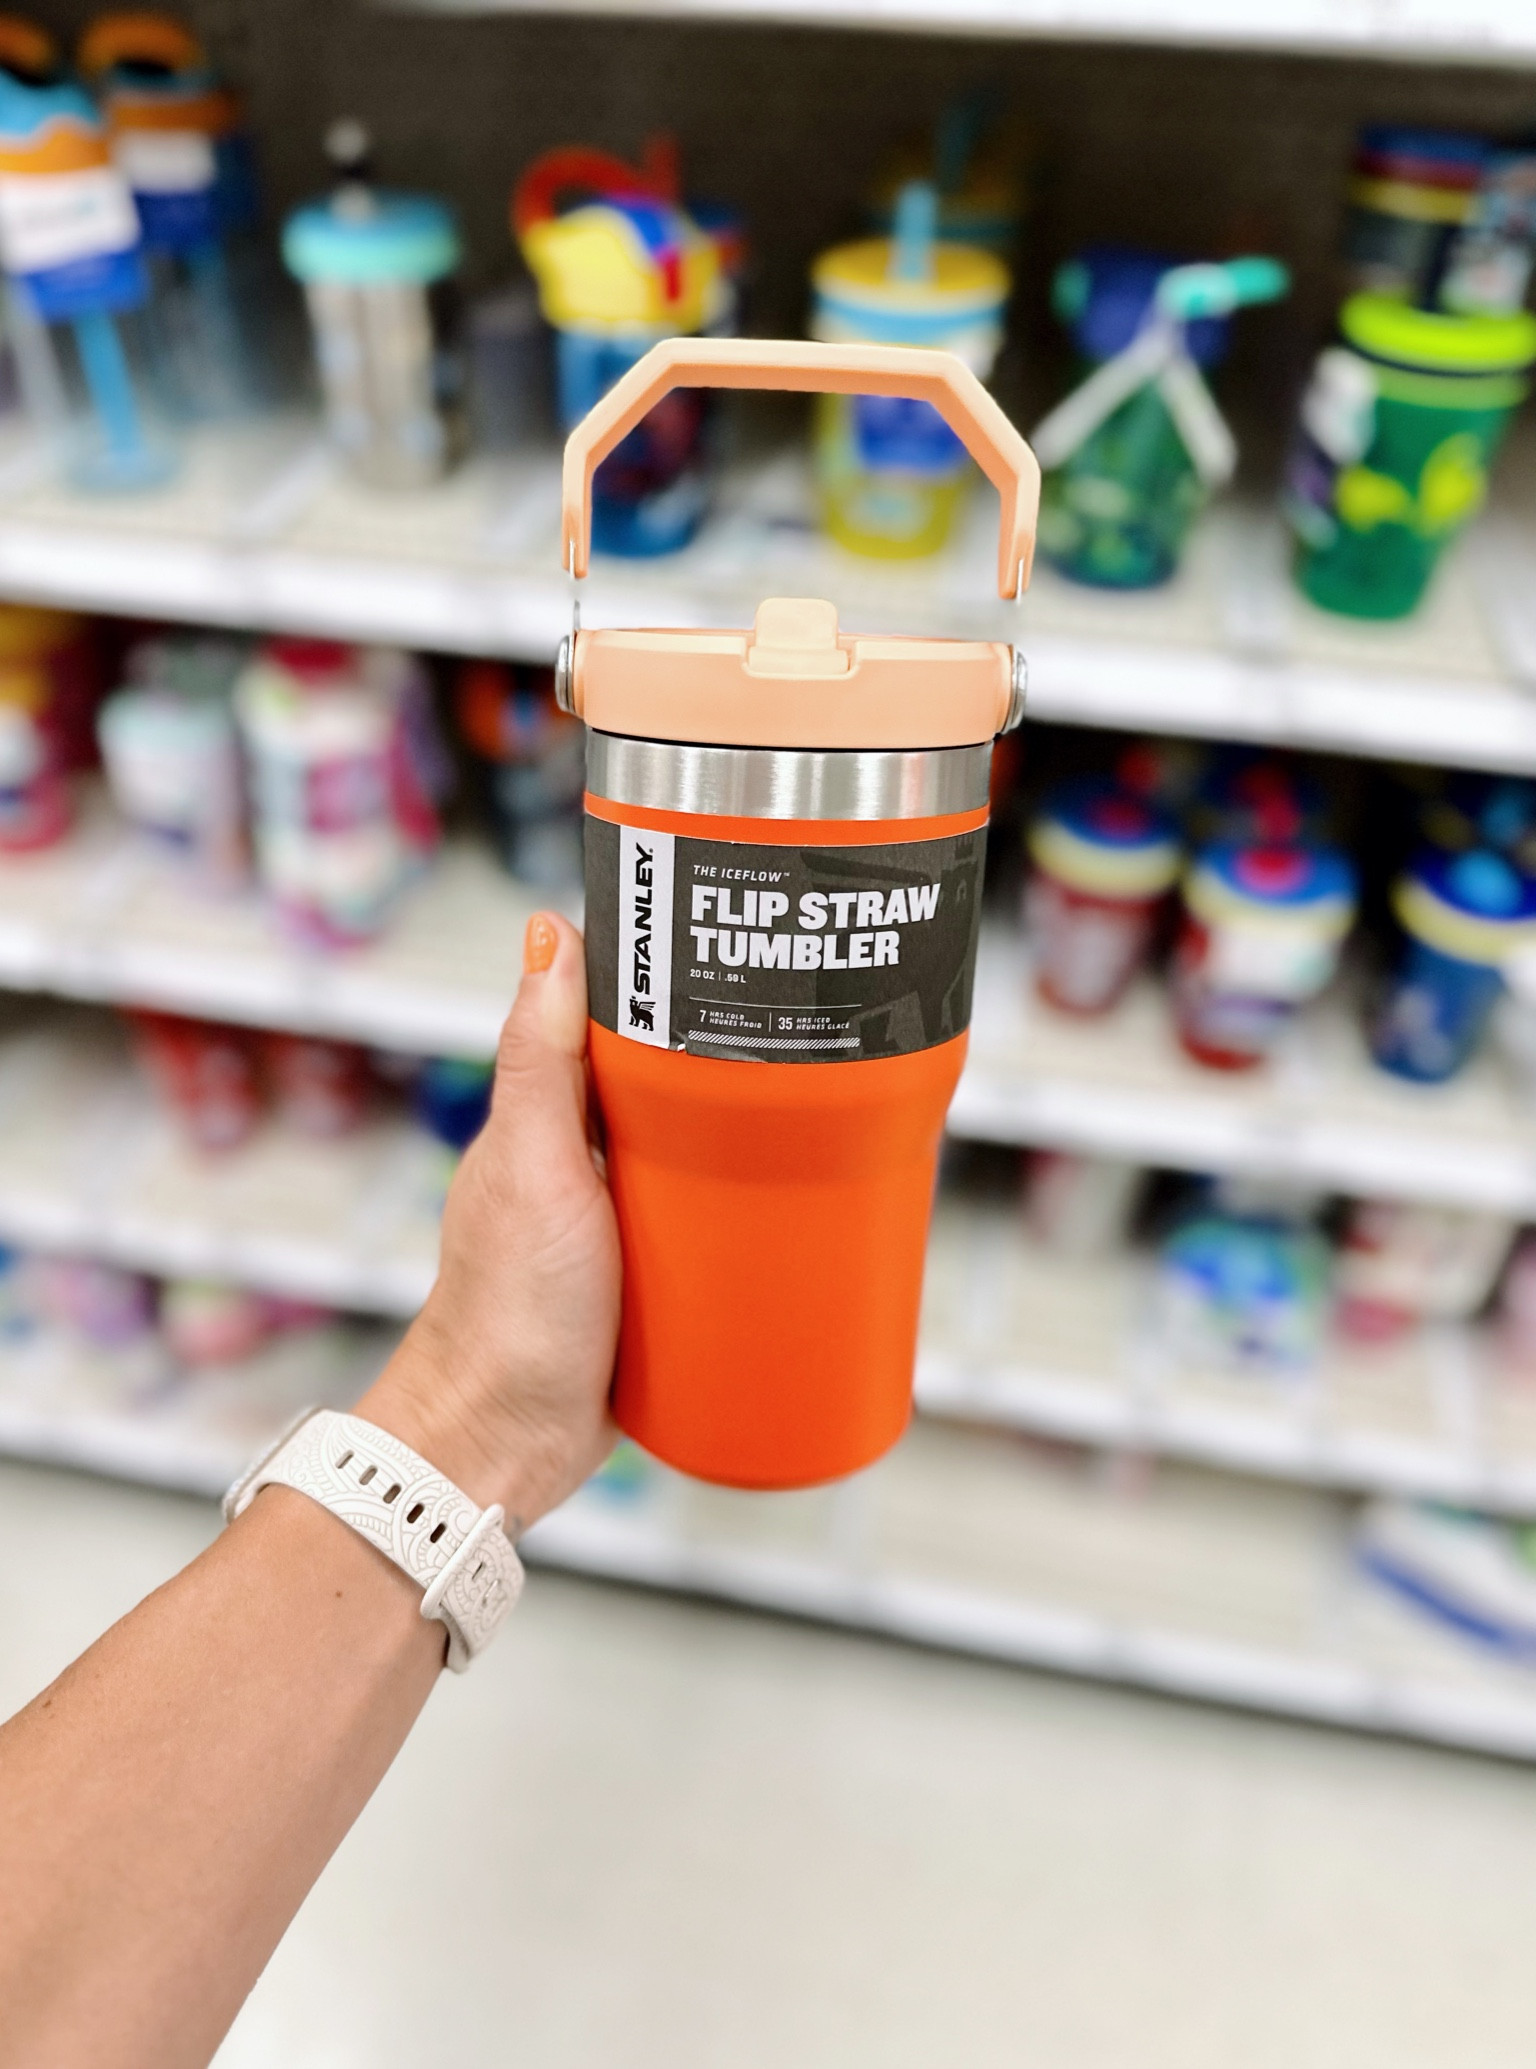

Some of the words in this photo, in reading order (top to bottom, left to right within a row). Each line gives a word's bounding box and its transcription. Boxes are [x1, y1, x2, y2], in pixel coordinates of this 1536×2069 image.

[693, 864, 717, 877] THE
[691, 884, 789, 927] FLIP
[798, 883, 941, 930] STRAW
[690, 925, 900, 971] TUMBLER
[689, 968, 701, 978] 20
[703, 970, 715, 980] OZ
[740, 975, 747, 984] L
[699, 1010, 707, 1022] 7
[710, 1011, 724, 1019] HRS
[709, 1017, 738, 1027] HEURES
[739, 1020, 762, 1029] FROID
[778, 1017, 793, 1030] 35
[796, 1023, 825, 1031] HEURES
